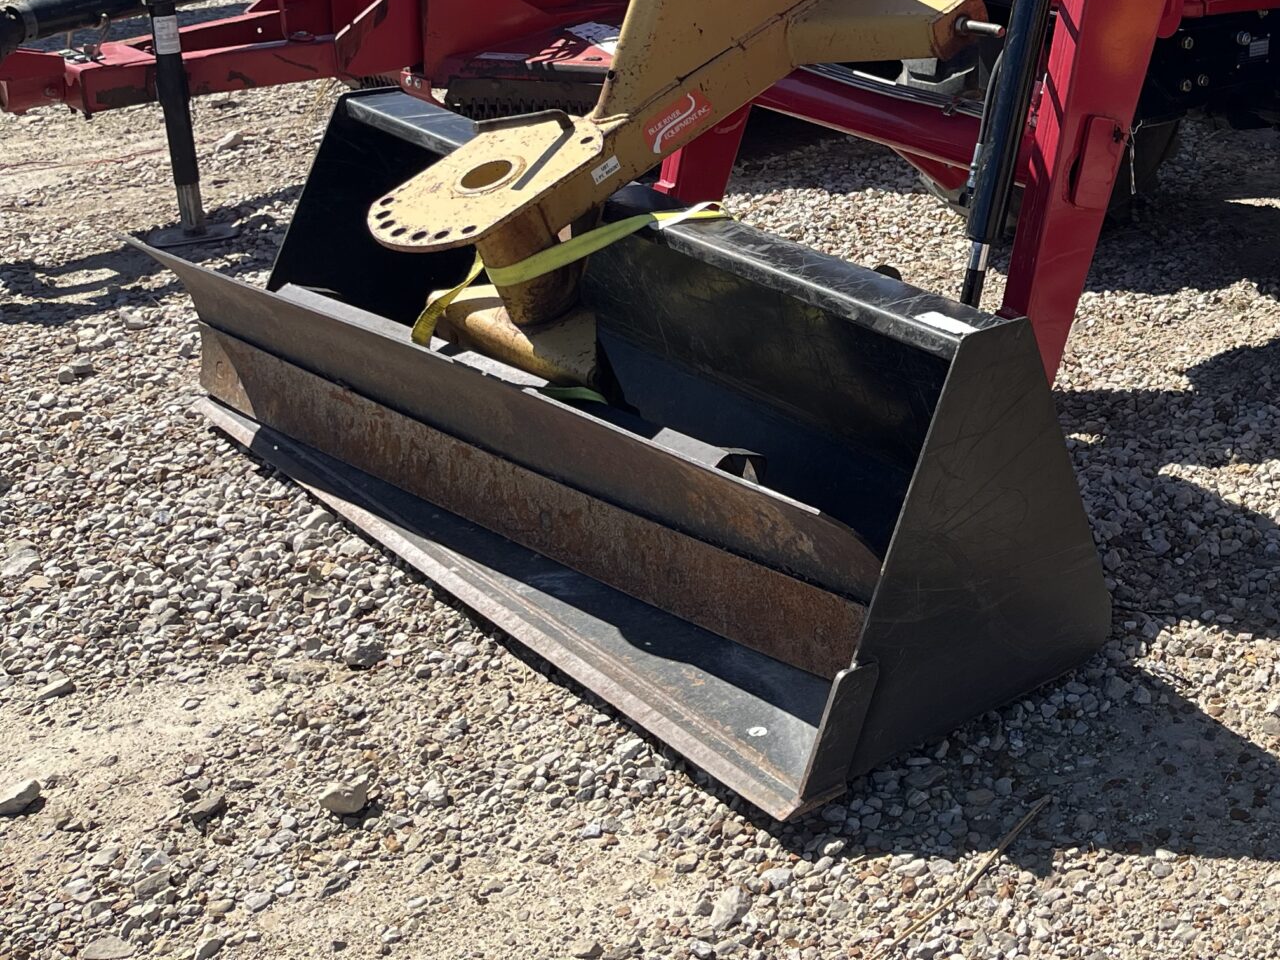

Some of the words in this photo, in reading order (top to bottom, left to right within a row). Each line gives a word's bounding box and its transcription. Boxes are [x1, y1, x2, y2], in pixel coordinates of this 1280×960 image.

[648, 121, 663, 135] BLUE
[663, 109, 681, 125] RIVER
[664, 114, 698, 140] EQUIPMENT
